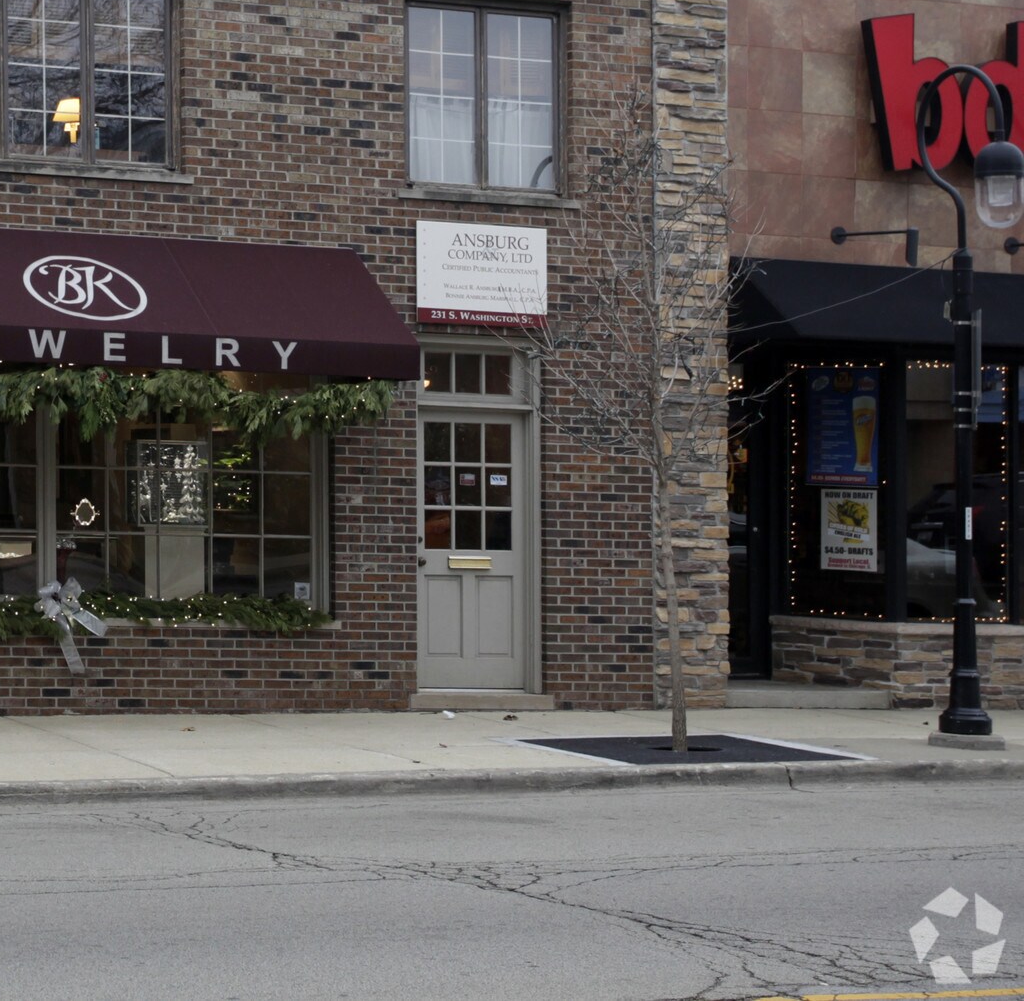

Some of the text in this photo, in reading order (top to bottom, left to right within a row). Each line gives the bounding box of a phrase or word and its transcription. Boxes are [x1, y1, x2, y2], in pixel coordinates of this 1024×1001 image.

[451, 233, 529, 250] ANSBURG
[447, 249, 533, 264] COMPANY, LTD
[473, 265, 494, 273] PUBLIC
[431, 310, 446, 319] 231
[449, 311, 457, 320] S.
[460, 311, 519, 324] WASHINGTON
[824, 491, 842, 499] NOW
[852, 492, 874, 500] DRAFT
[848, 547, 874, 556] DRAFTS
